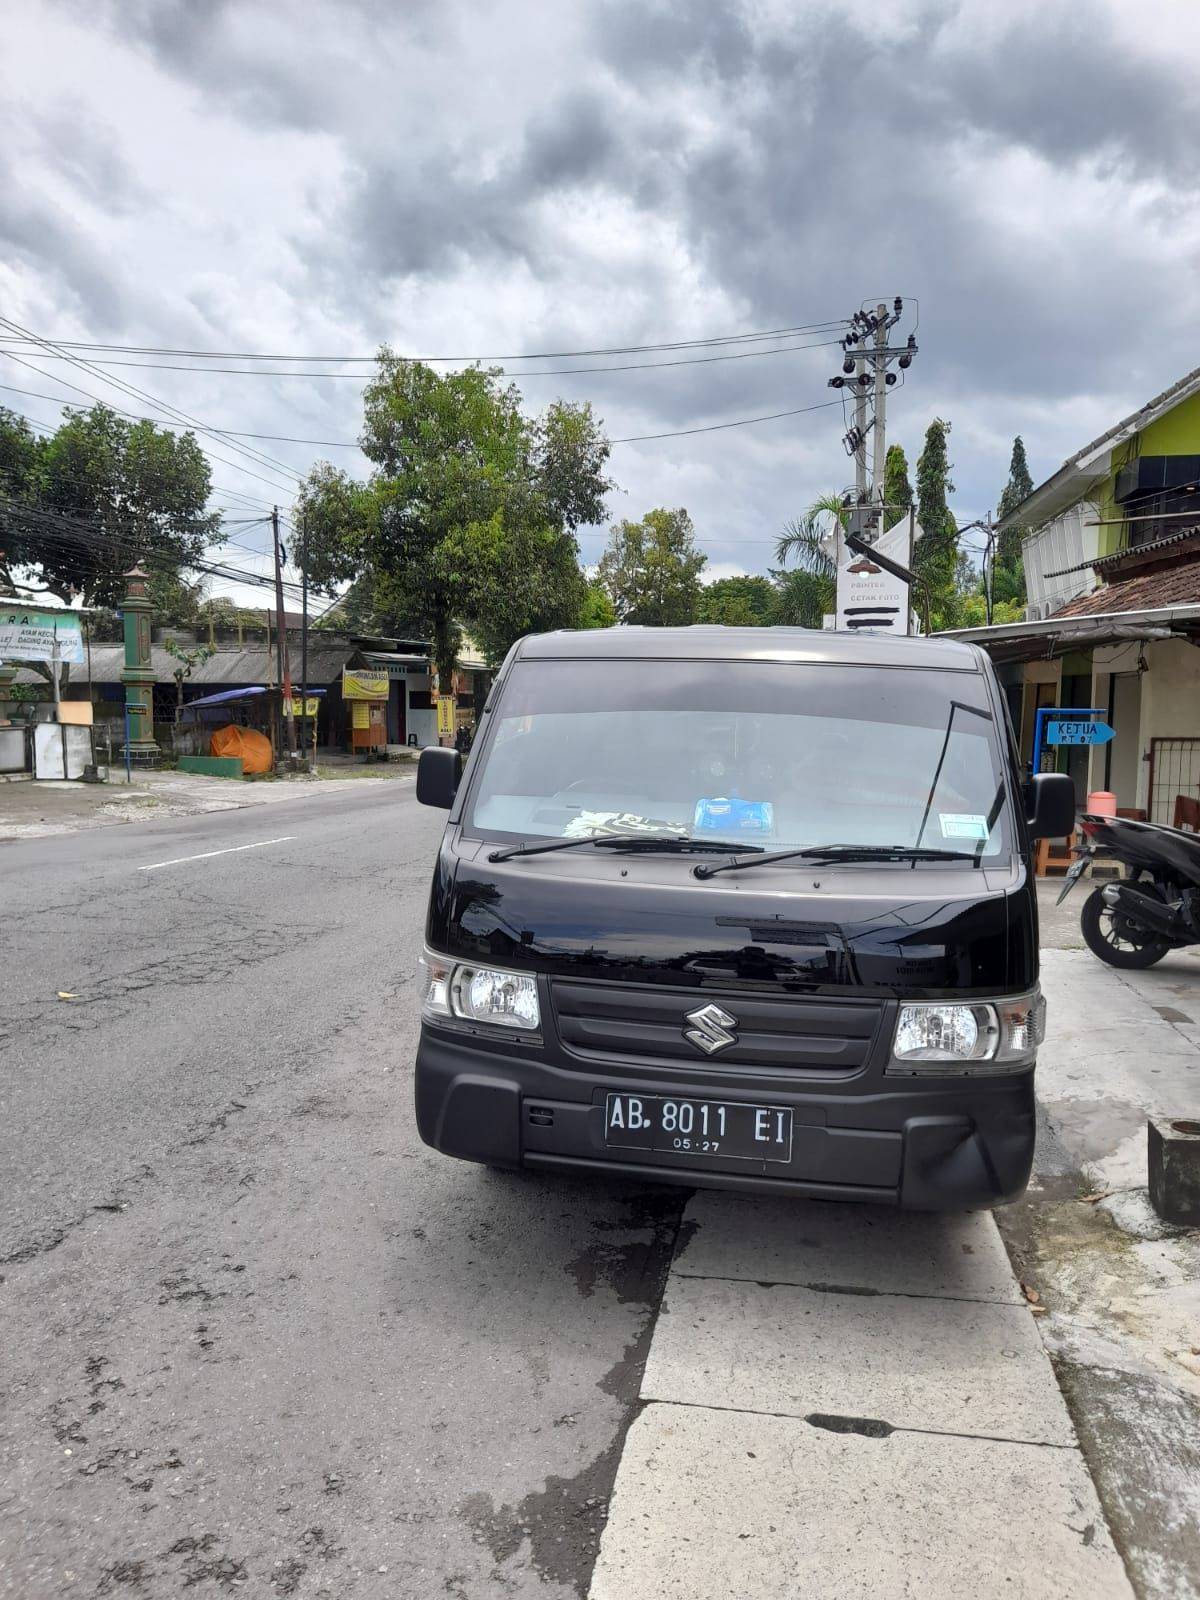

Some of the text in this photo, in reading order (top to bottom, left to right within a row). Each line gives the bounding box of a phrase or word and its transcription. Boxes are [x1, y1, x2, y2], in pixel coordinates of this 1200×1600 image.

[1057, 722, 1097, 735] KETUA
[1061, 735, 1075, 743] RT
[661, 1102, 726, 1137] 8011
